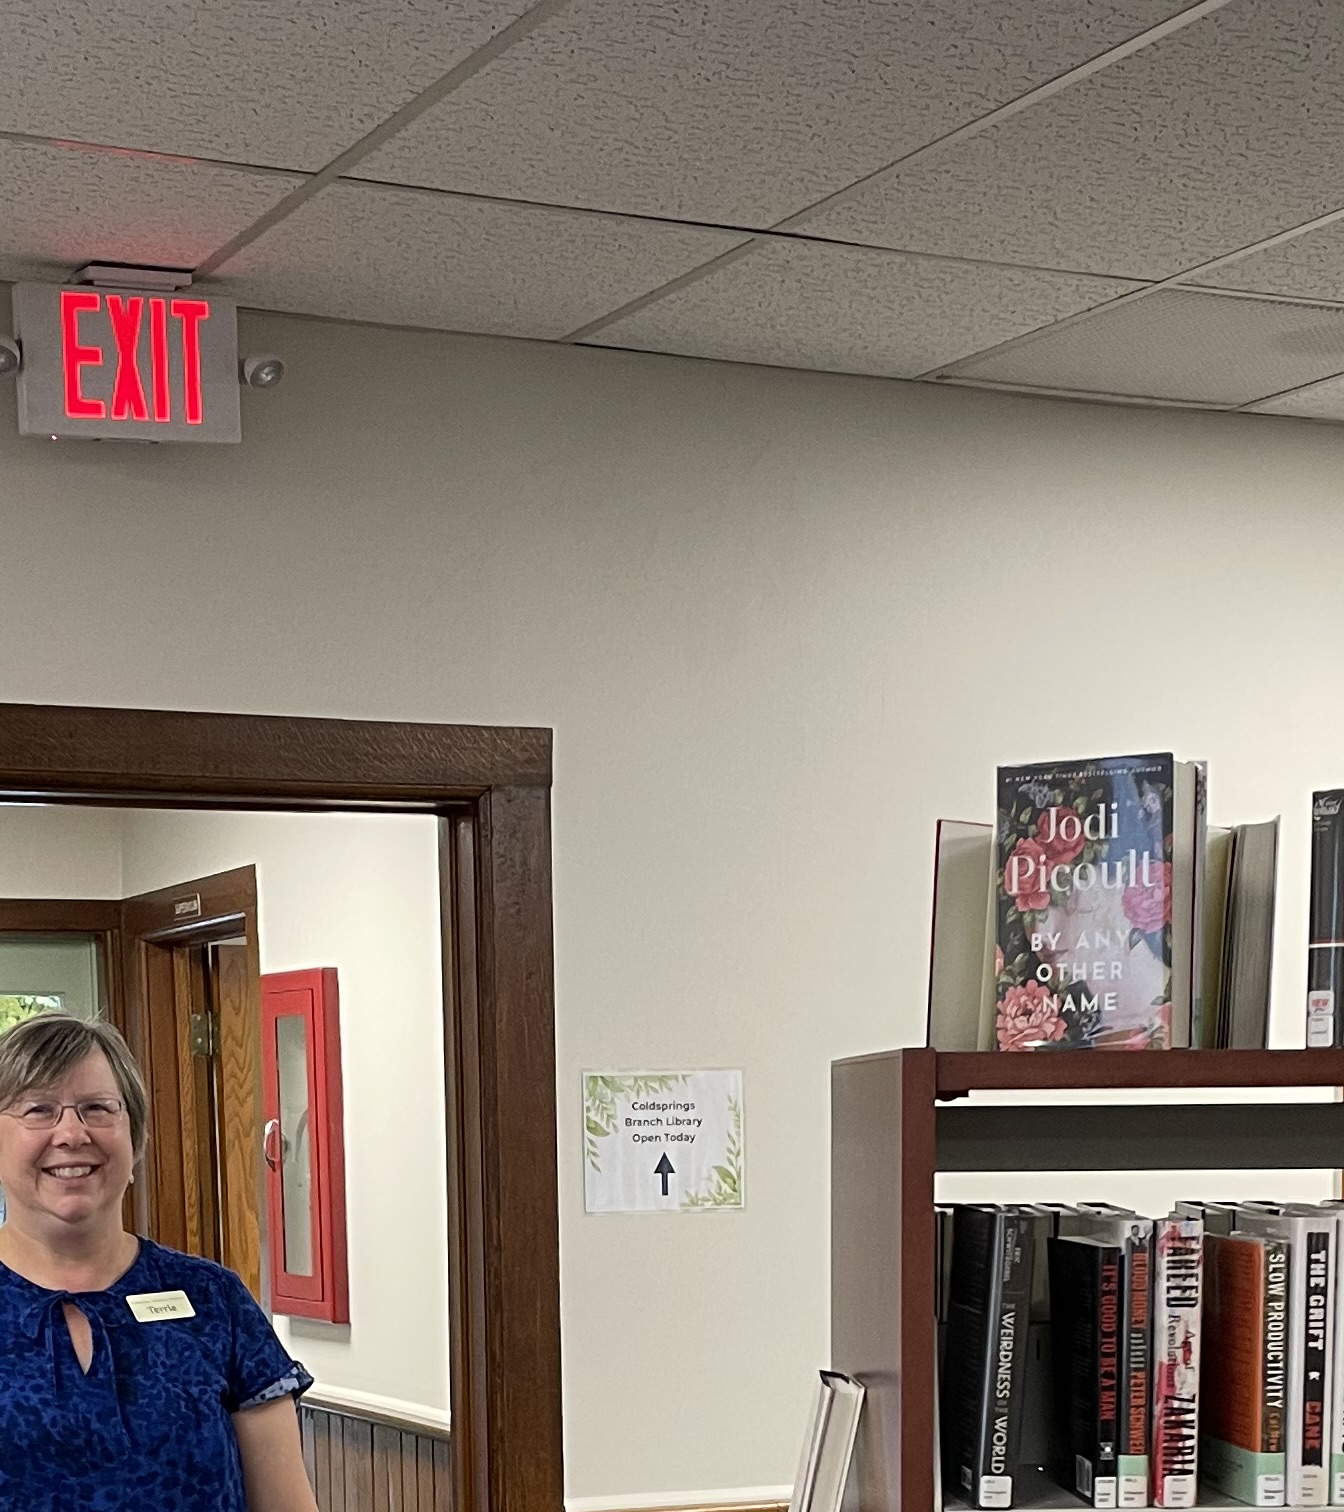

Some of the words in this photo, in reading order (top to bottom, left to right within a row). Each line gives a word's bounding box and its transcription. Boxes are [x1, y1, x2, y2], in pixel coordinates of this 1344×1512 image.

[61, 291, 209, 425] EXIT
[1045, 802, 1120, 844] Jodi
[1008, 848, 1155, 896] Picoult
[625, 1117, 663, 1127] Branch
[666, 1116, 703, 1128] Library
[631, 1101, 696, 1112] Coldsprings
[632, 1133, 662, 1144] Open
[665, 1133, 696, 1144] Today
[1310, 1250, 1326, 1288] THE
[995, 1311, 1016, 1400] WEIRDNESS
[1265, 1300, 1286, 1410] PRODUCTIVITY
[1130, 1371, 1147, 1406] PETER
[990, 1406, 1009, 1475] WORLD
